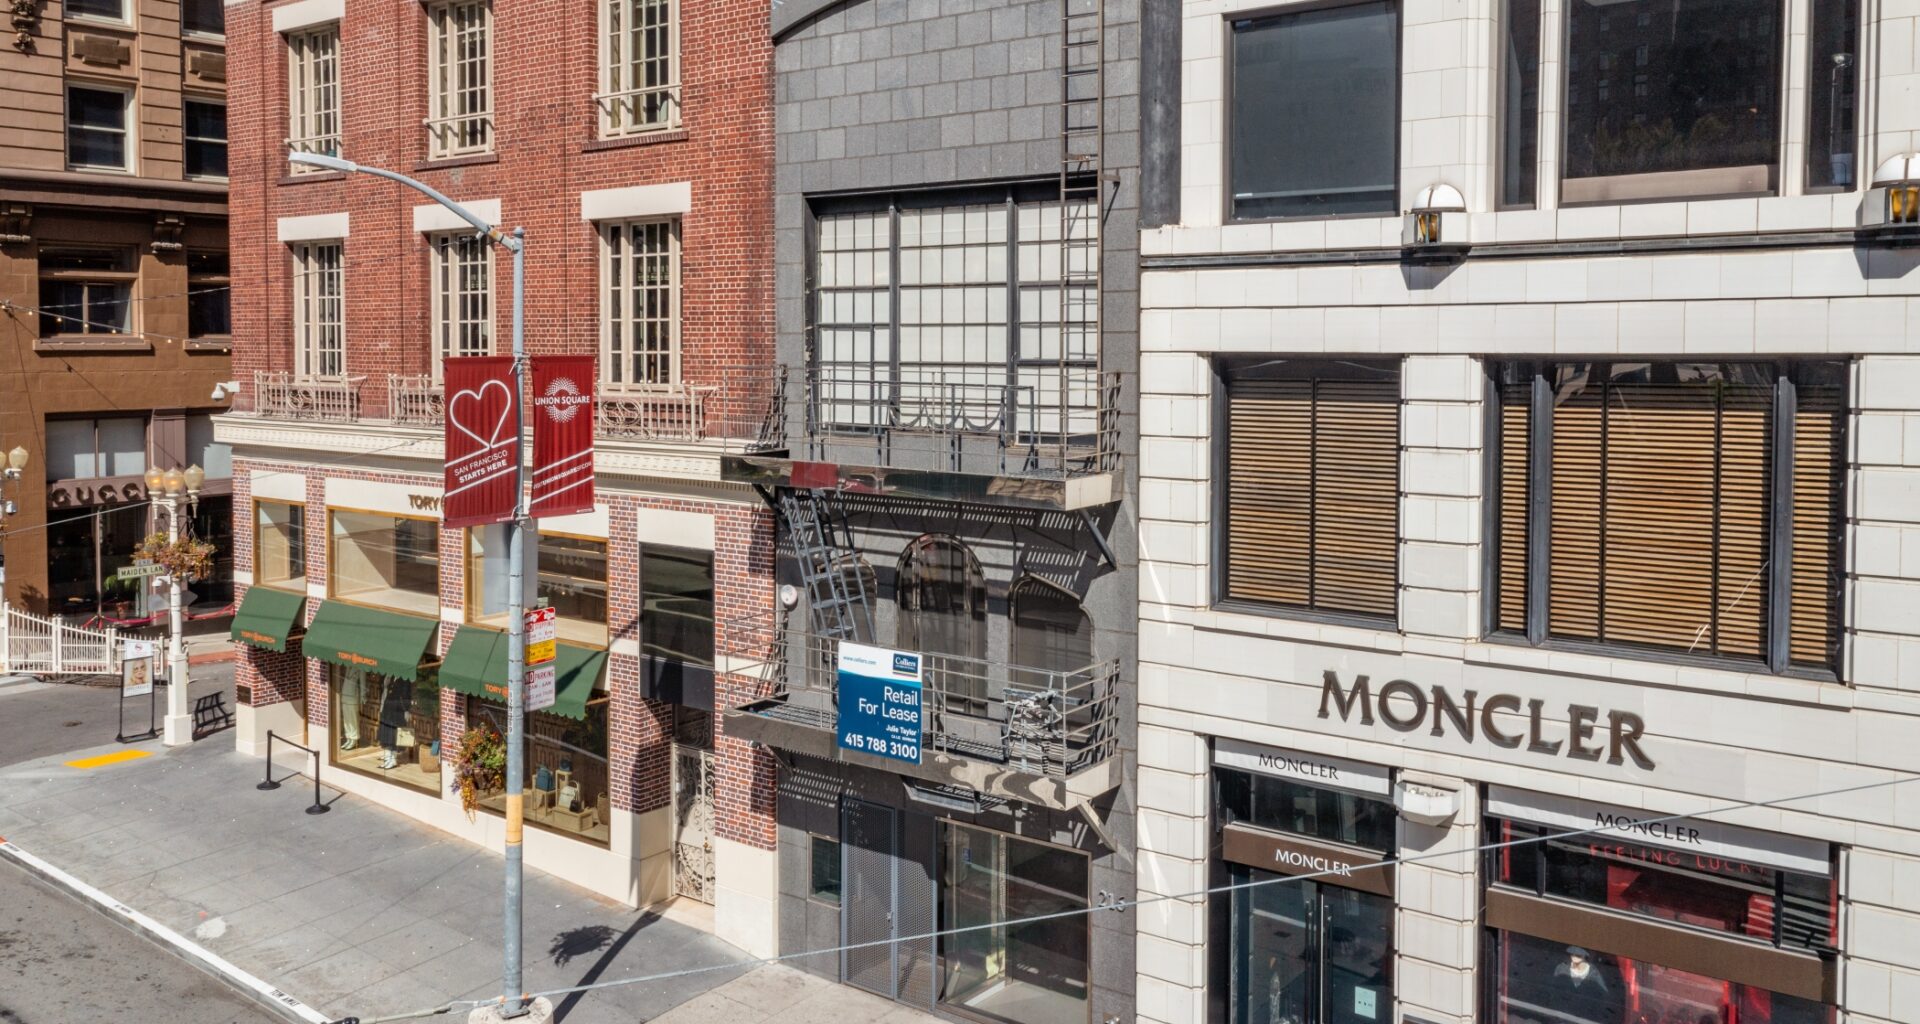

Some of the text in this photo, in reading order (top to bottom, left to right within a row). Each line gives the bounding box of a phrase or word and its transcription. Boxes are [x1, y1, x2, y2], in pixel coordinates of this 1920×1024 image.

[535, 395, 590, 405] UNION SQUARE
[454, 450, 508, 476] SAN FRANCISCO
[459, 459, 507, 483] STARTS HERE
[408, 494, 440, 511] TORY
[121, 565, 164, 576] MAIDEN LAN
[338, 652, 377, 665] TORY BURCH
[895, 657, 917, 667] Colliers
[535, 671, 553, 681] PARKING
[485, 684, 501, 694] TORY
[884, 686, 918, 706] Retail
[859, 698, 918, 723] For Lease
[1317, 669, 1656, 770] MONCLER
[886, 725, 917, 737] Julie Taylor
[845, 732, 864, 748] 415
[866, 737, 887, 753] 788
[890, 741, 918, 760] 3100
[1258, 753, 1339, 780] MONCLER
[1594, 812, 1702, 845] MONCLER
[1274, 849, 1352, 877] MONCLER
[1589, 843, 1681, 865] FEELING
